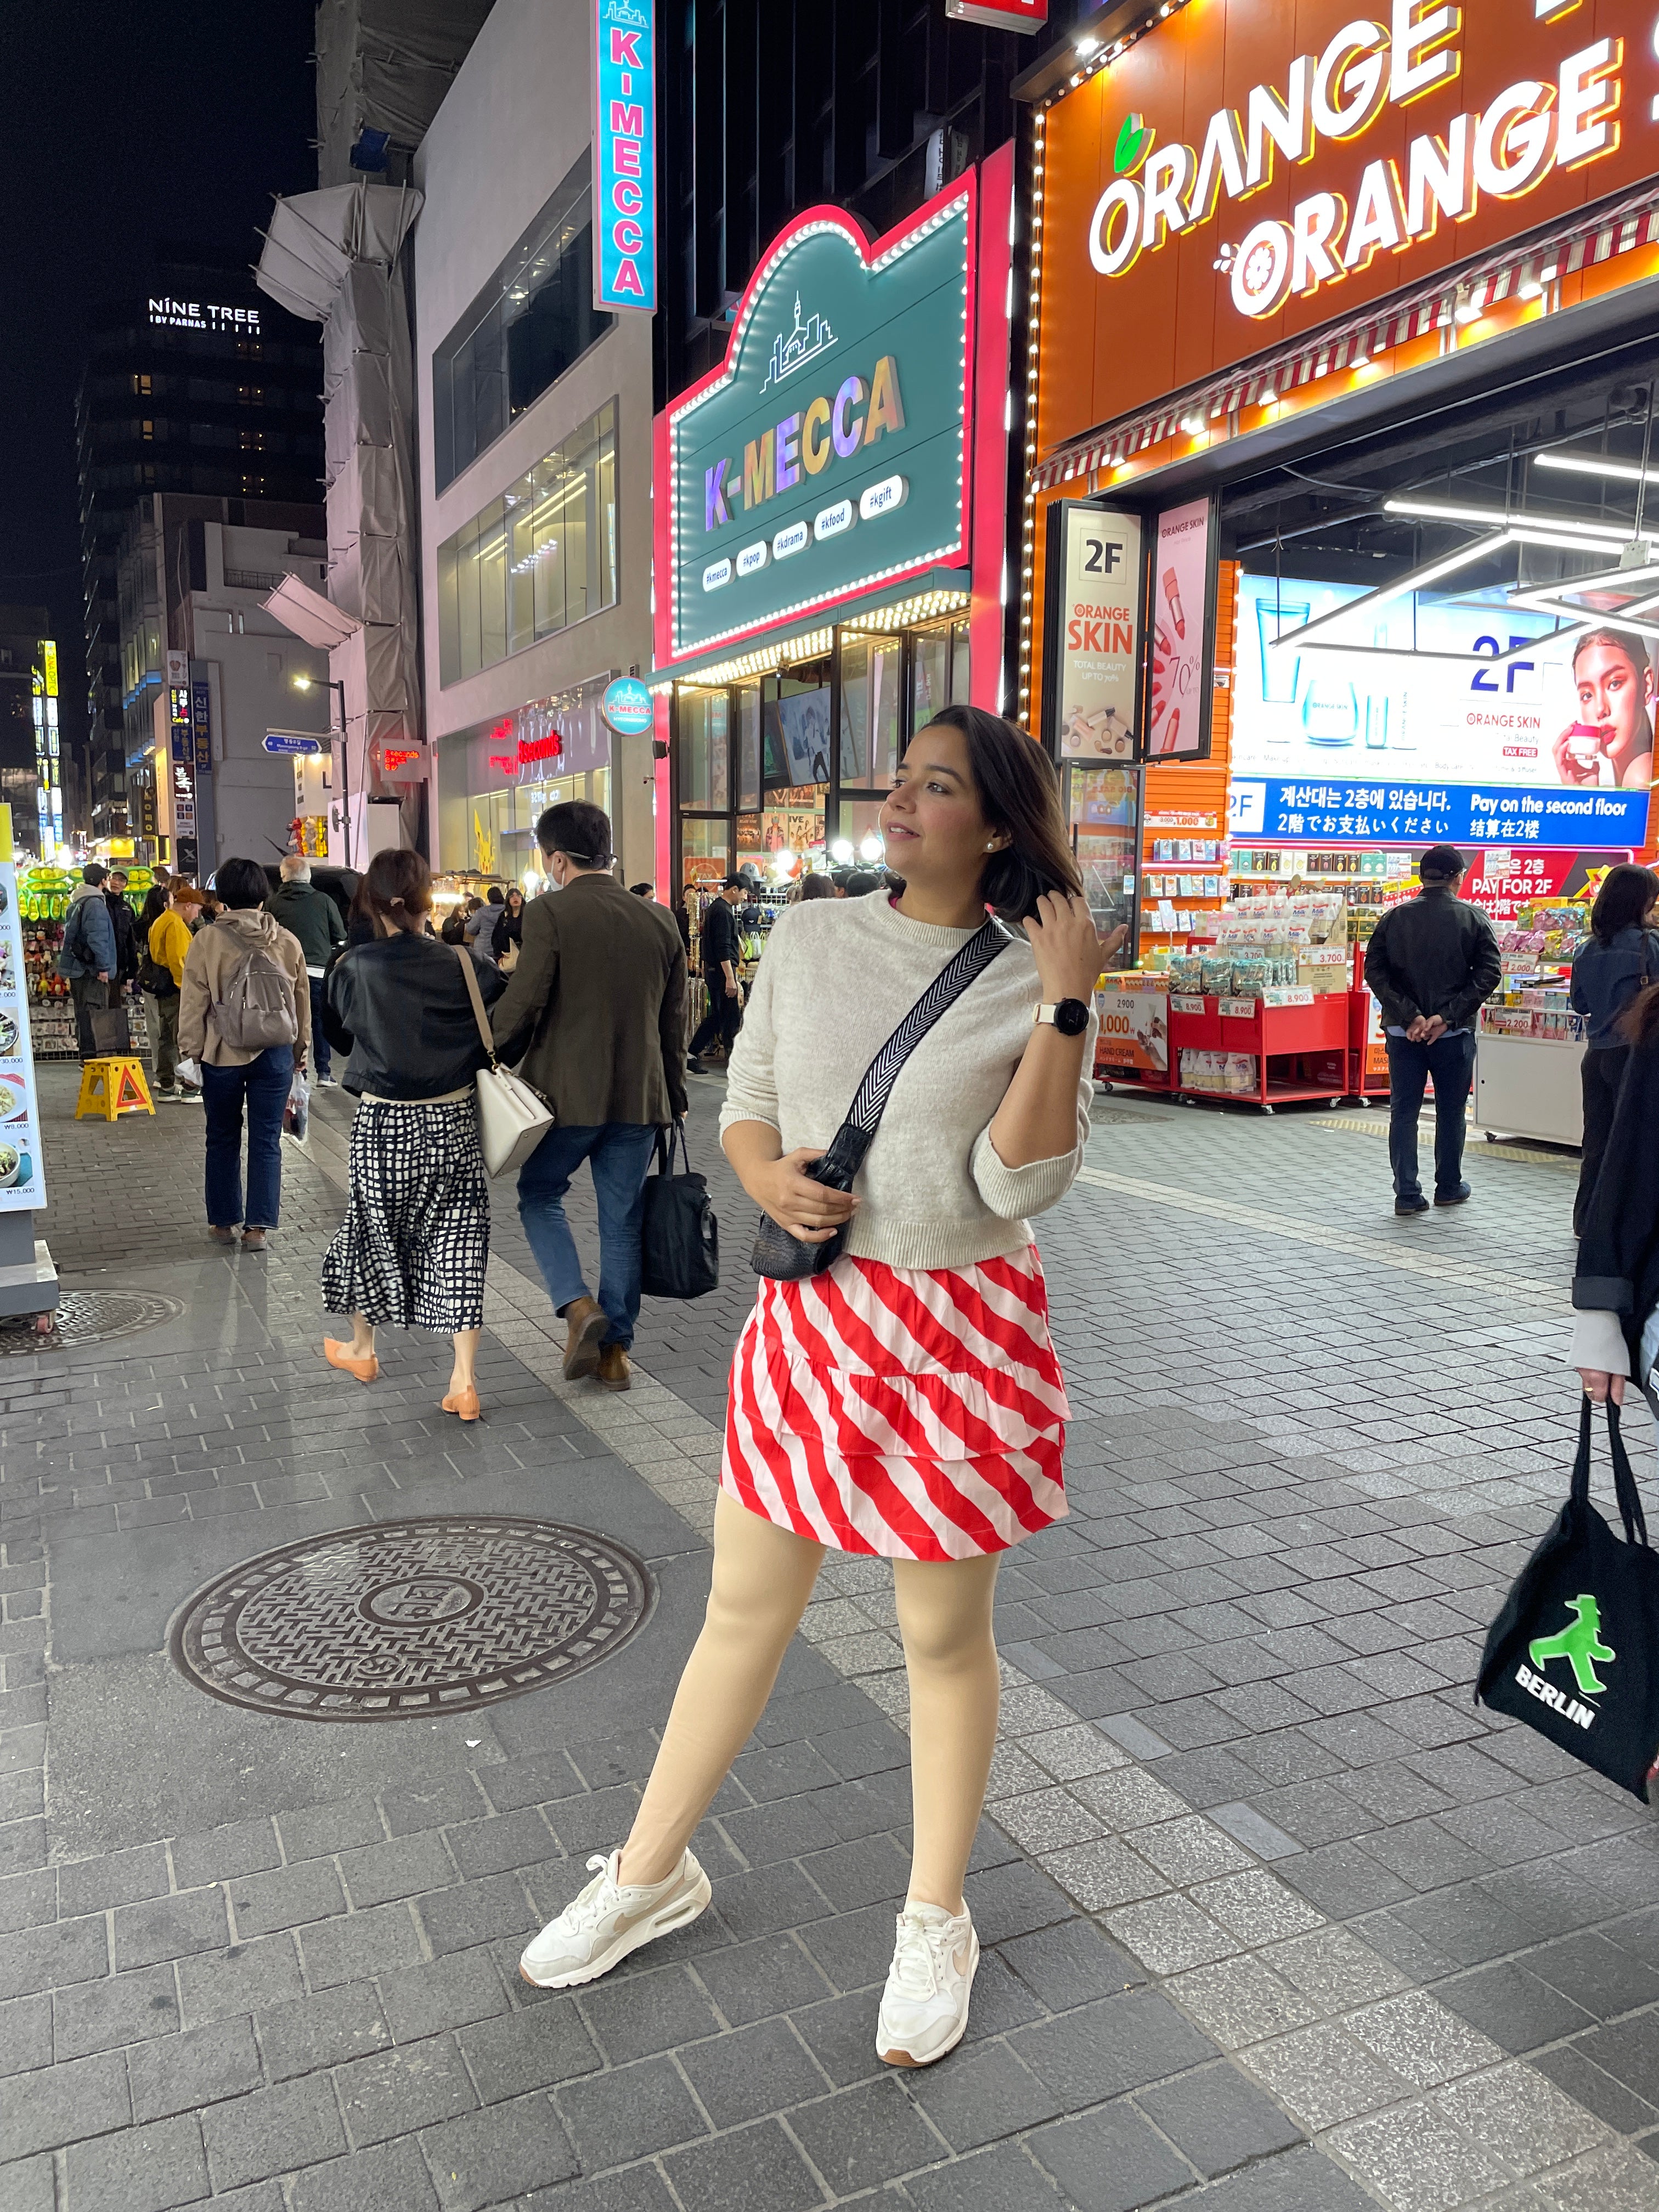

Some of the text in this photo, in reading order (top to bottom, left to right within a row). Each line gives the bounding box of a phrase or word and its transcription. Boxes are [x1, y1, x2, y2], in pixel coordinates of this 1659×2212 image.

[1090, 0, 1462, 276] ORANGE
[1231, 37, 1623, 318] ORANGE
[170, 317, 206, 328] PARNAS
[207, 306, 259, 323] TREE
[705, 356, 905, 532] K-MECCA
[870, 488, 892, 509] #kgift
[822, 510, 845, 530] #kfood
[1162, 517, 1204, 538] ORANGE SKIN
[777, 529, 803, 552] #kdrama
[743, 550, 760, 568] #kpop
[1085, 539, 1123, 573] 2F
[706, 566, 727, 585] #kmecca
[1074, 604, 1130, 621] ORANGE
[1068, 620, 1132, 654] SKIN
[1073, 661, 1126, 672] TOTAL BEAUTY
[1471, 636, 1534, 693] 2F
[1104, 674, 1119, 683] 70%
[609, 705, 651, 714] K-MECCA
[1467, 713, 1541, 729] ORANGE SKIN
[1504, 747, 1537, 757] TAX FREE
[1280, 786, 1451, 812] 계산대는 2층에 있습니다.
[1471, 794, 1627, 816] Pay on the second floor
[1277, 814, 1449, 835] 2階でお支払いください
[1470, 818, 1540, 839] 结算在2楼
[1523, 859, 1544, 874] 2층
[1472, 879, 1553, 894] PAY FOR 2F
[1320, 953, 1342, 963] 3,700
[1288, 994, 1309, 1003] 8,900
[1100, 1014, 1130, 1035] 1,000
[1506, 1019, 1528, 1028] 2,200
[1099, 1047, 1134, 1057] HAND CREAM
[1515, 1664, 1595, 1729] BERLIN
